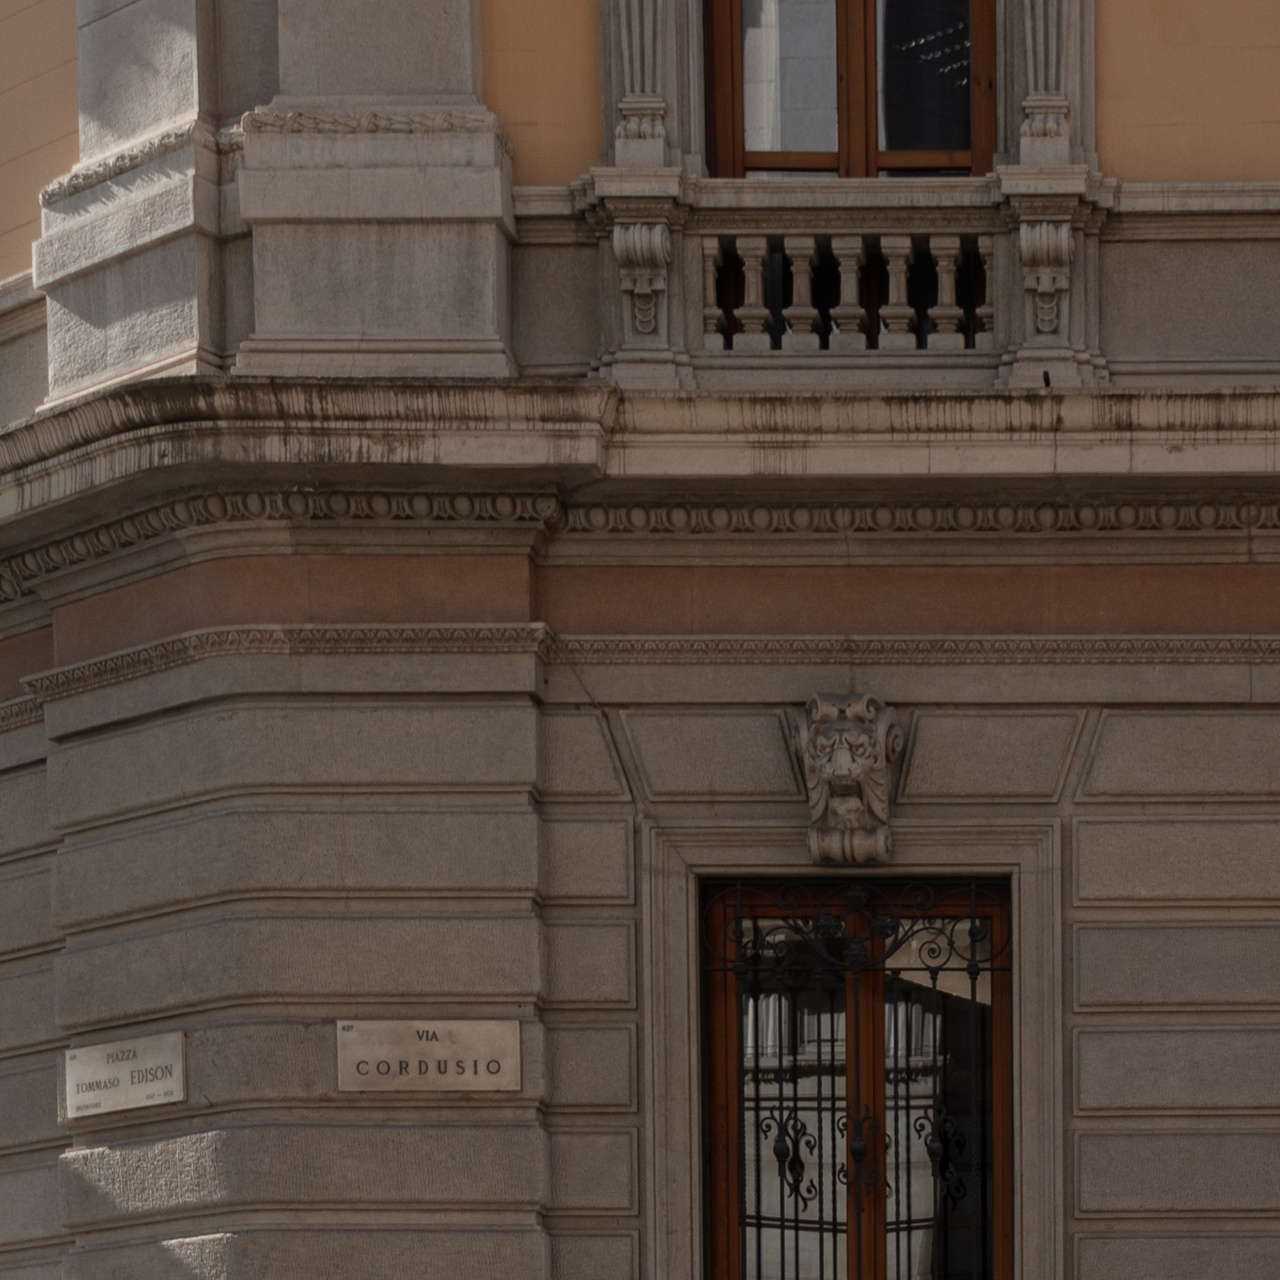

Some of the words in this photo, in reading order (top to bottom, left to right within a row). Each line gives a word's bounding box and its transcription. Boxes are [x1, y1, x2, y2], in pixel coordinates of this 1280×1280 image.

[416, 1030, 439, 1042] VIA
[106, 1049, 138, 1064] PIAZZA
[356, 1059, 502, 1076] CORDUSIO
[76, 1077, 120, 1095] TOMMASO
[130, 1064, 174, 1086] EDISON
